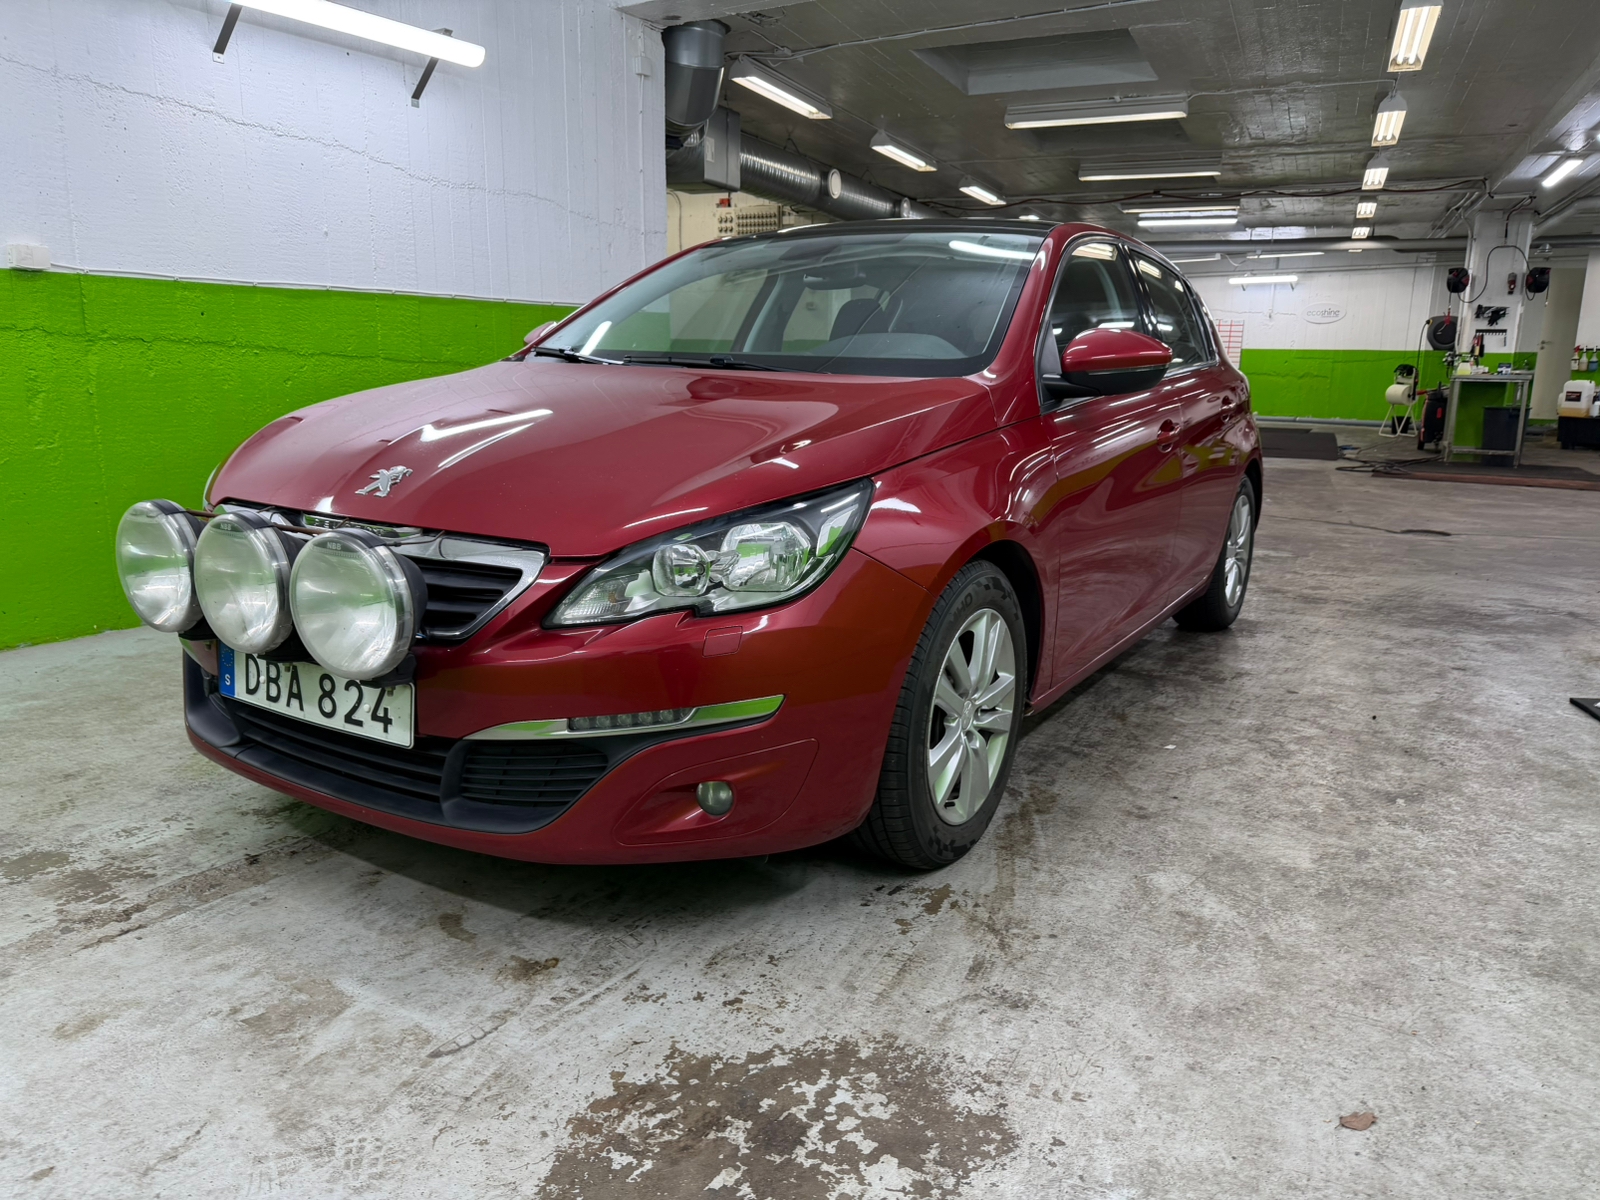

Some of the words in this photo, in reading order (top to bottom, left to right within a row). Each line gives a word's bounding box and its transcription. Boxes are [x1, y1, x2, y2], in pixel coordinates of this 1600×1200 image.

[1306, 308, 1340, 316] ecoshine
[327, 541, 342, 550] NBB
[224, 674, 231, 686] S
[245, 653, 304, 711] DBA
[318, 673, 393, 733] 824
